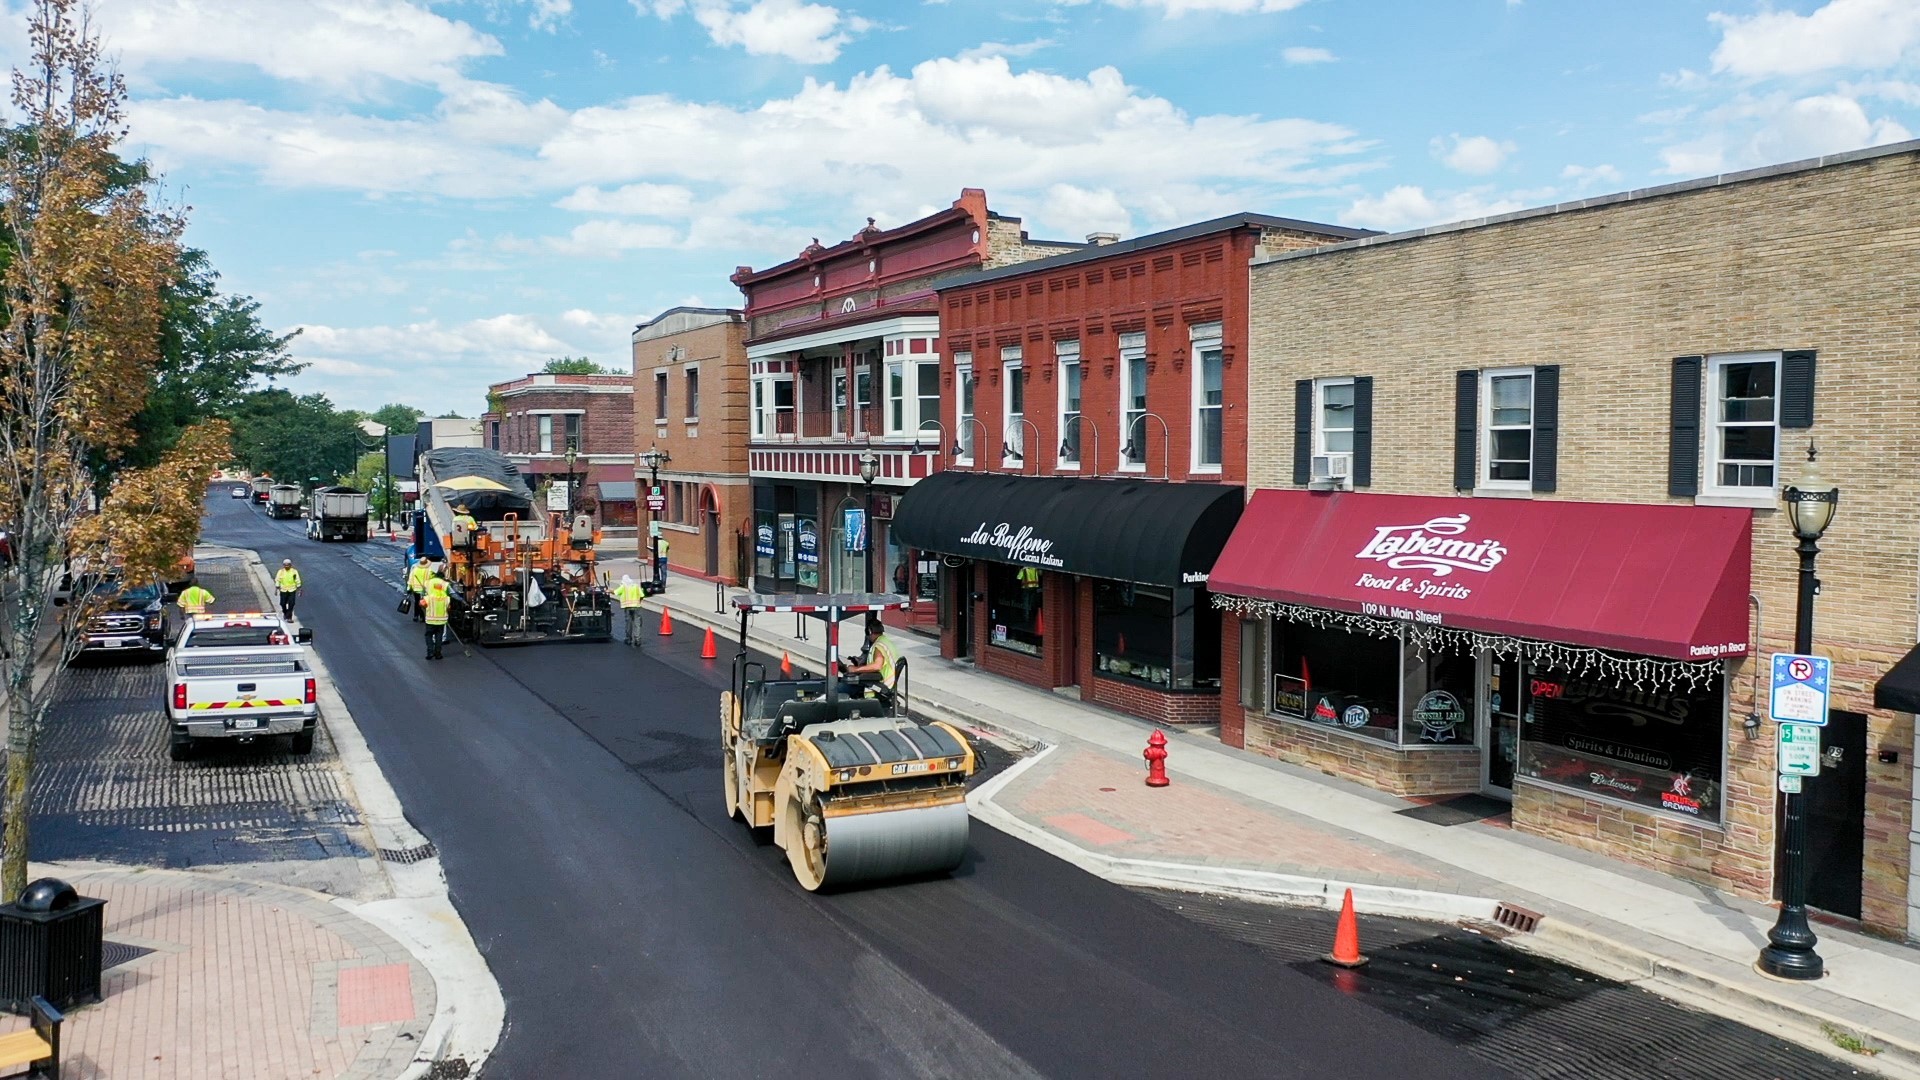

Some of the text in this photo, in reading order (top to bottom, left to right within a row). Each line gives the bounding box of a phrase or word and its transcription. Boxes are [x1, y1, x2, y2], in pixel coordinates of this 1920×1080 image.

[989, 522, 1053, 560] Baffone
[1019, 549, 1064, 567] Cucina Italiana
[1355, 573, 1471, 599] Food & Spirits
[1361, 602, 1442, 625] 109 N. Main Street
[1690, 642, 1746, 657] Parking in Rear
[1530, 680, 1561, 698] OPEN
[1417, 712, 1443, 720] CRYSTAL
[1782, 728, 1791, 739] 15
[1569, 736, 1669, 768] Spirits & Libations
[893, 764, 907, 774] CAT
[1662, 800, 1699, 815] BREWING
